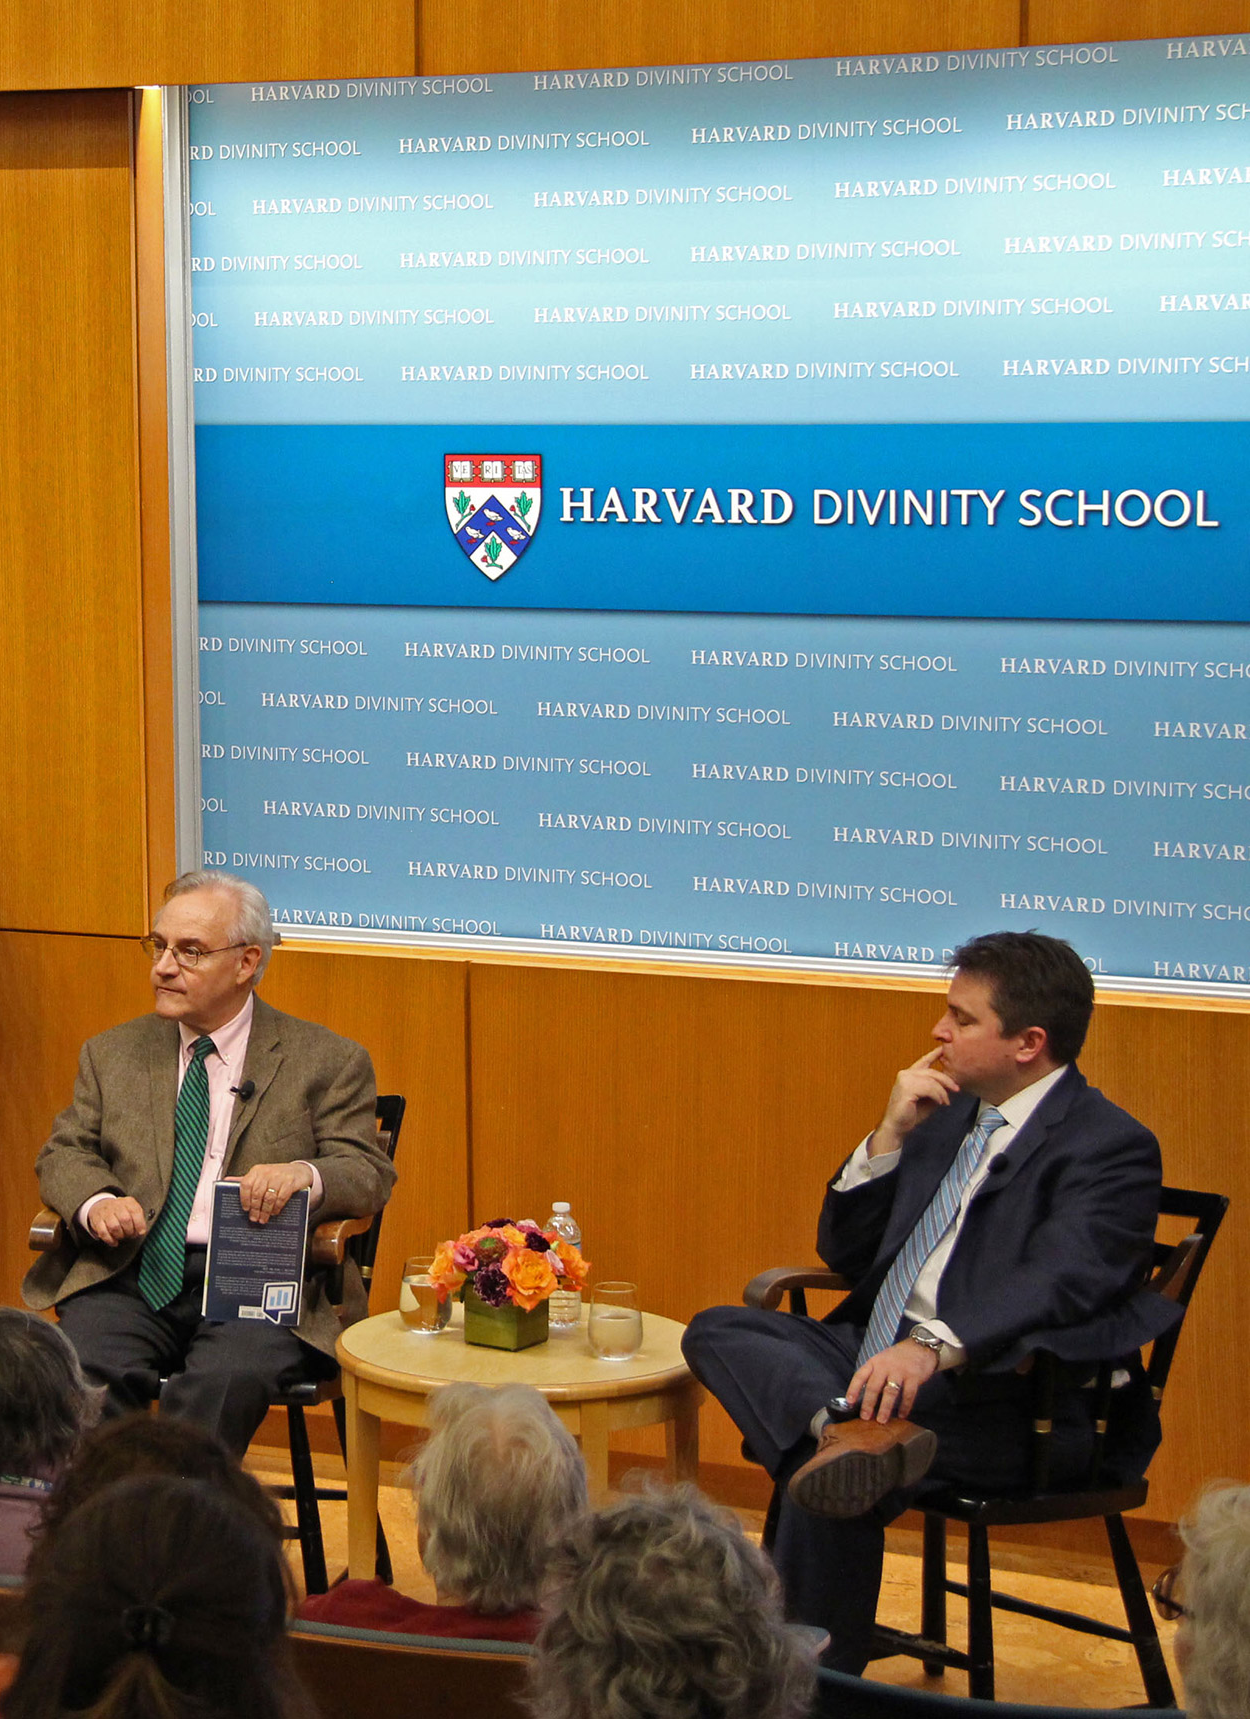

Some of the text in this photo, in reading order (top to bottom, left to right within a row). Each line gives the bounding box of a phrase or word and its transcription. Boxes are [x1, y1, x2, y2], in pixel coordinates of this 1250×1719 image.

[1167, 40, 1250, 59] HARVA
[837, 47, 1118, 76] HARVARD DIVINITY SCHOOL
[534, 65, 793, 90] HARVARD DIVINITY SCHOOL
[251, 78, 493, 101] HARVARD DIVINITY SCHOOL
[1007, 103, 1250, 130] HARVARD DIVINITY SCH
[692, 117, 962, 143] HARVARD DIVINITY SCHOOL
[220, 143, 288, 159] DIVINITY
[293, 140, 361, 157] SCHOOL
[399, 130, 649, 153] HARVARD DIVINITY SCHOOL
[835, 173, 1115, 197] HARVARD DIVINITY SCHOOL
[1163, 167, 1250, 186] HARVA
[253, 194, 493, 214] HARVARD DIVINITY SCHOOL
[534, 185, 792, 207] HARVARD DIVINITY SCHOOL
[691, 240, 960, 261] HARVARD DIVINITY SCHOOL
[1005, 231, 1250, 253] HARVARD DIVINITY SCH
[222, 256, 289, 271] DIVINITY
[294, 254, 362, 269] SCHOOL
[401, 248, 649, 267] HARVARD DIVINITY SCHOOL
[534, 304, 791, 322] HARVARD DIVINITY SCHOOL
[834, 297, 1113, 318] HARVARD DIVINITY SCHOOL
[1160, 294, 1250, 311] HARVAR
[254, 309, 494, 326] HARVARD DIVINITY SCHOOL
[224, 367, 291, 381] DIVINITY
[296, 367, 363, 381] SCHOOL
[401, 365, 649, 380] HARVARD DIVINITY SCHOOL
[691, 361, 959, 379] HARVARD DIVINITY SCHOOL
[1003, 357, 1249, 376] HARVARD DIVINITY SCH
[560, 487, 1219, 527] HARVARD DIVINITY SCHOOL
[229, 638, 295, 653] DIVINITY
[300, 640, 367, 655] SCHOOL
[405, 642, 650, 663] HARVARD DIVINITY SCHOOL
[692, 650, 957, 671] HARVARD DIVINITY SCHOOL
[1001, 658, 1250, 678] HARVARD DIVINITY SCH
[262, 693, 497, 714] HARVARD DIVINITY SCHOOL
[537, 702, 790, 724] HARVARD DIVINITY SCHOOL
[833, 712, 1108, 735] HARVARD DIVINITY SCHOOL
[1154, 722, 1250, 739] HARVAR
[231, 746, 298, 761] DIVINITY
[302, 748, 369, 764] SCHOOL
[407, 752, 651, 776] HARVARD DIVINITY SCHOOL
[692, 764, 957, 788] HARVARD DIVINITY SCHOOL
[1000, 776, 1250, 800] HARVARD DIVINITY SCH
[264, 800, 499, 825] HARVARD DIVINITY SCHOOL
[539, 813, 791, 839] HARVARD DIVINITY SCHOOL
[833, 827, 1108, 854] HARVARD DIVINITY SCHOOL
[1154, 842, 1250, 860] HARVAR
[233, 853, 299, 869] DIVINITY
[304, 856, 371, 873] SCHOOL
[409, 861, 652, 888] HARVARD DIVINITY SCHOOL
[693, 877, 957, 905] HARVARD DIVINITY SCHOOL
[1001, 894, 1250, 921] HARVARD DIVINITY SCH
[359, 913, 427, 931] DIVINITY
[432, 917, 501, 935] SCHOOL
[540, 924, 791, 952] HARVARD DIVINITY SCHOOL
[834, 942, 934, 961] HARVARD
[1154, 961, 1250, 980] HARVAR
